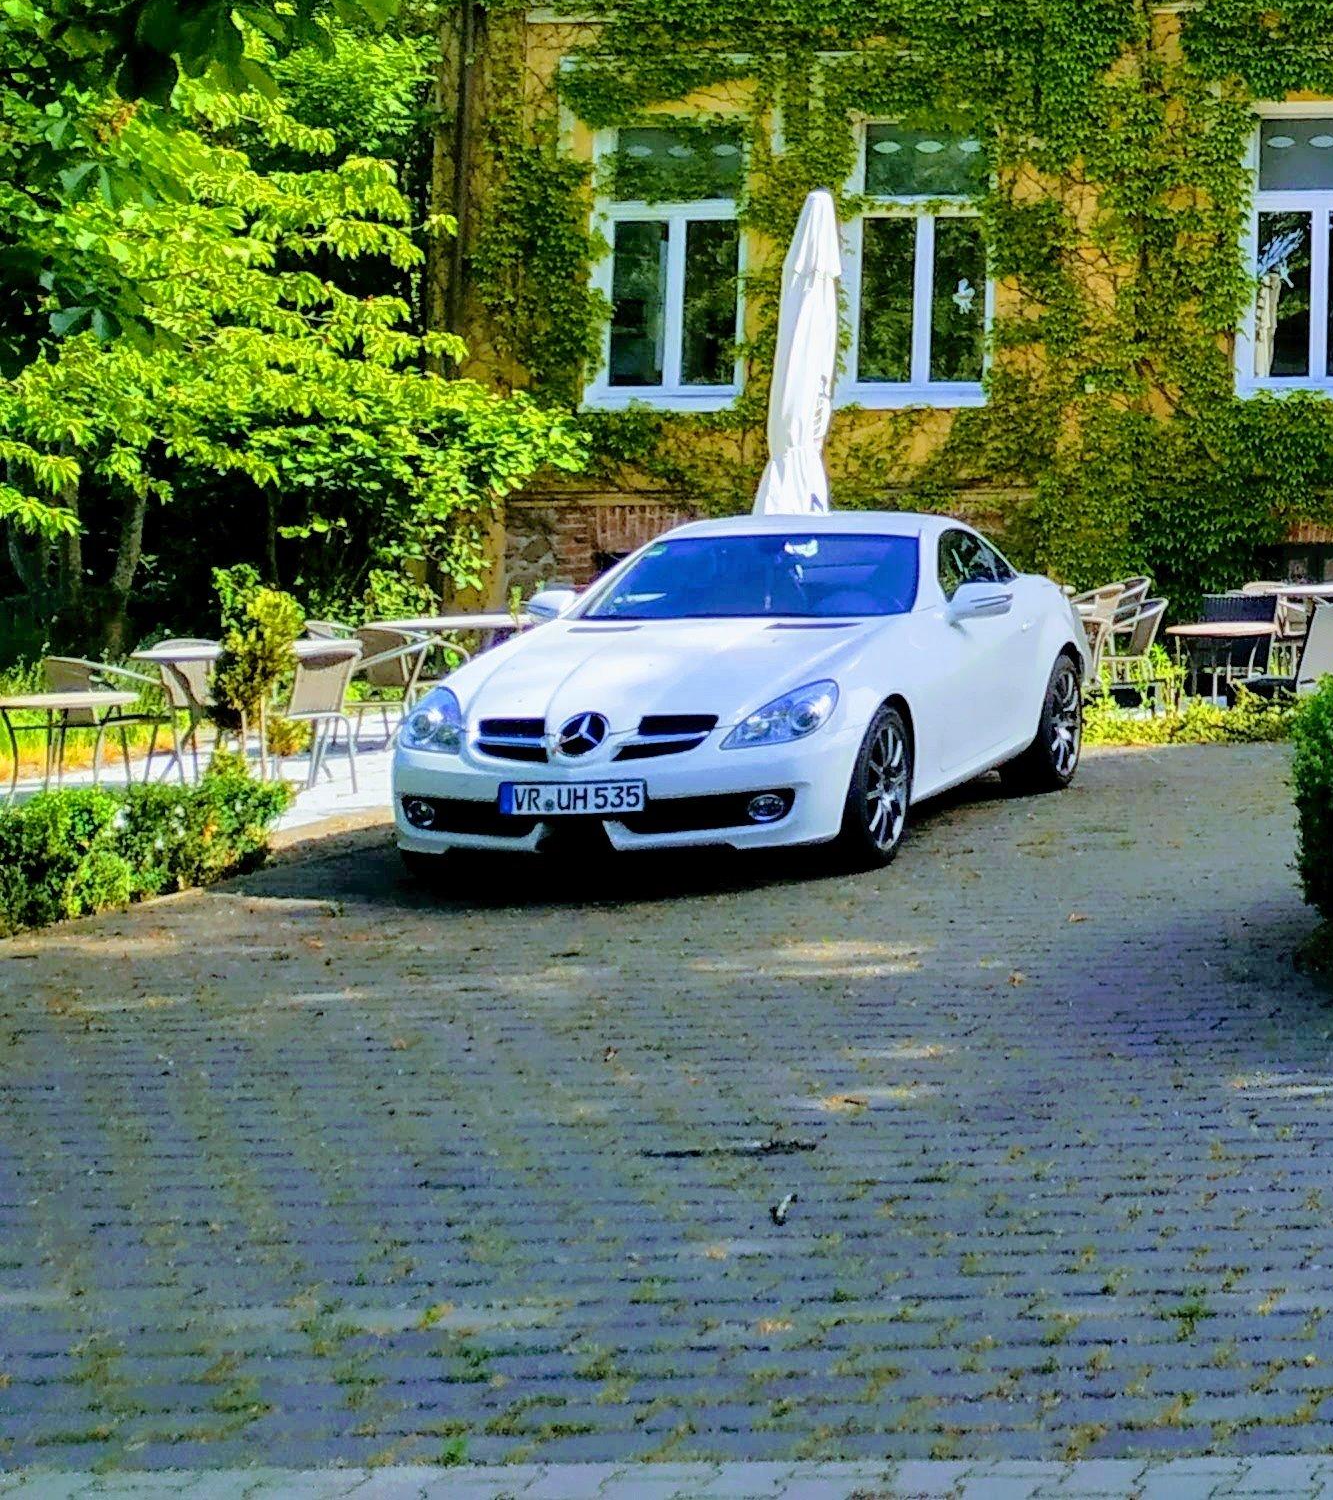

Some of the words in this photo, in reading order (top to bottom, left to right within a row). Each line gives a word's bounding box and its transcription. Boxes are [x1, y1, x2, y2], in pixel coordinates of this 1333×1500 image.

[514, 788, 540, 811] VR
[557, 787, 588, 811] UH
[594, 785, 640, 810] 535
